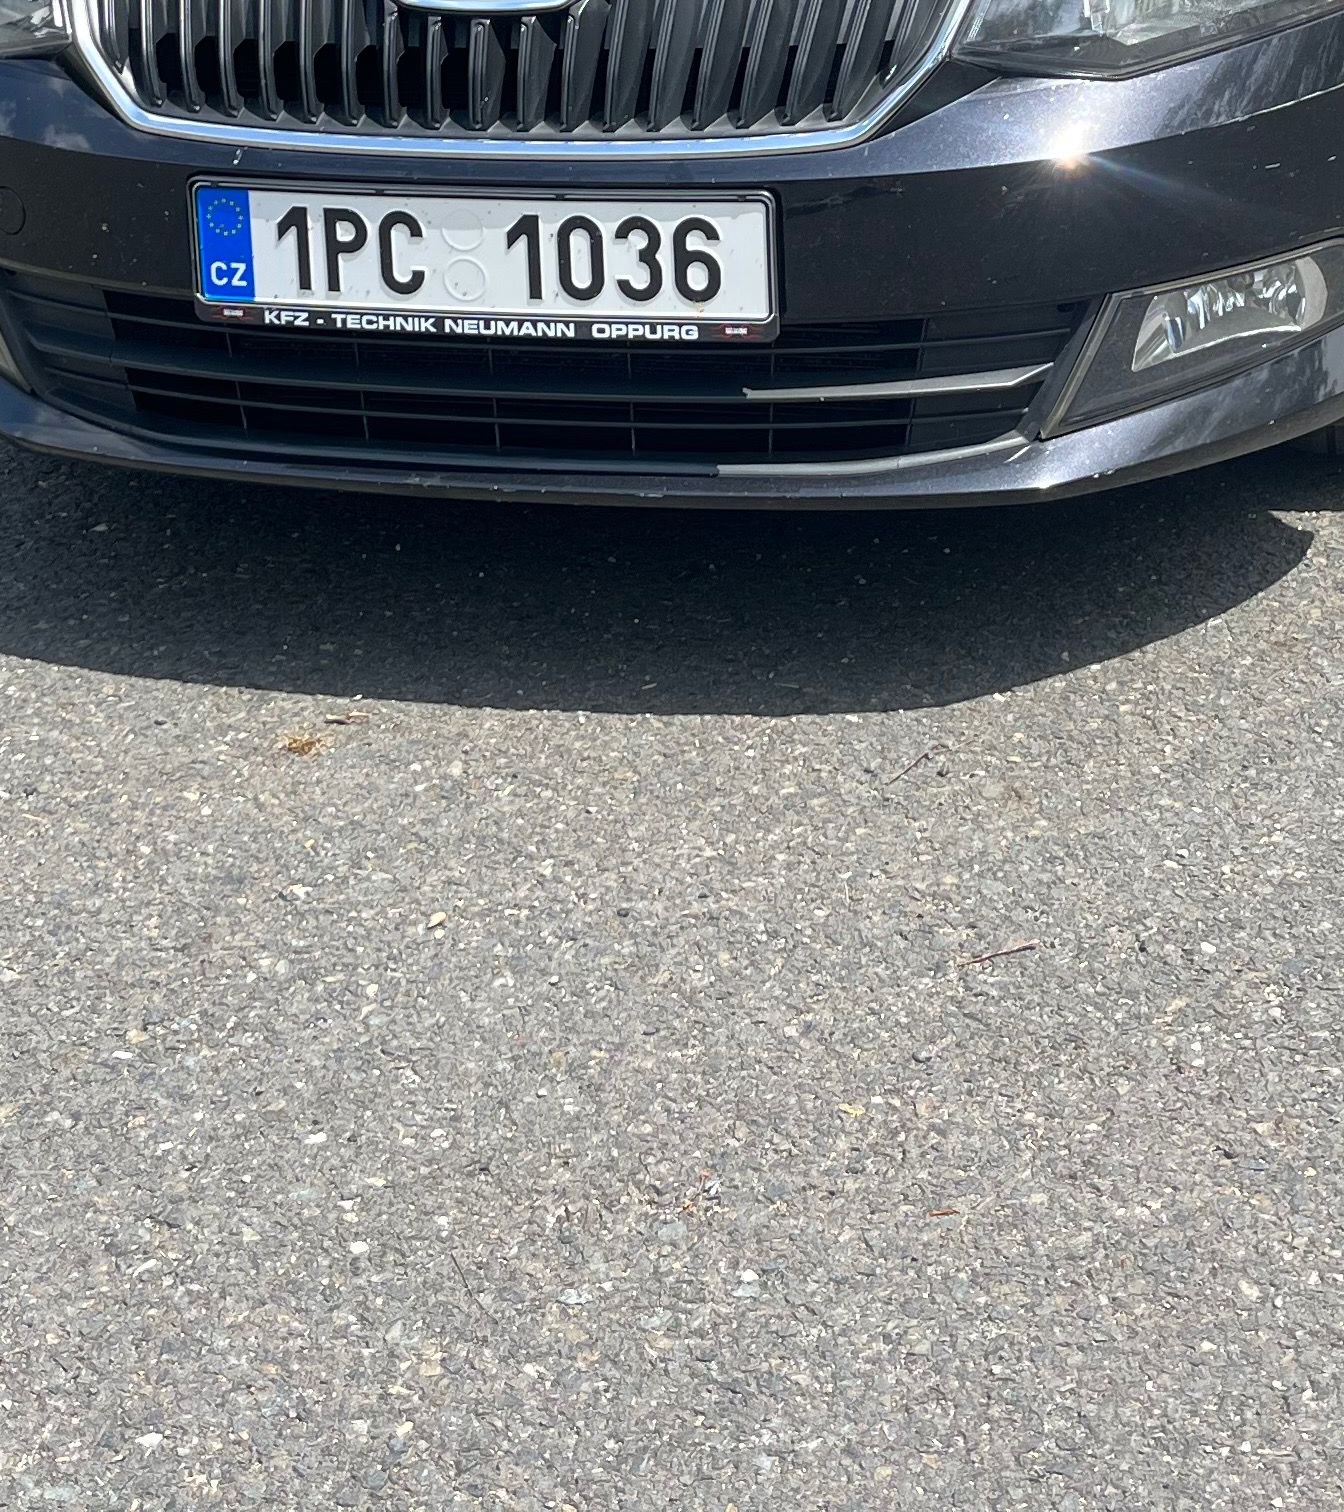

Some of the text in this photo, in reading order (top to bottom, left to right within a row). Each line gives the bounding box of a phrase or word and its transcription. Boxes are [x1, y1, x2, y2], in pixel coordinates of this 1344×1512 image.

[277, 205, 722, 303] 1PC 1036
[210, 261, 248, 287] CZ
[264, 310, 310, 326] KFZ
[331, 313, 437, 333] TECHNIK
[444, 318, 575, 338] NEUMANN
[591, 322, 699, 340] OPPURG
